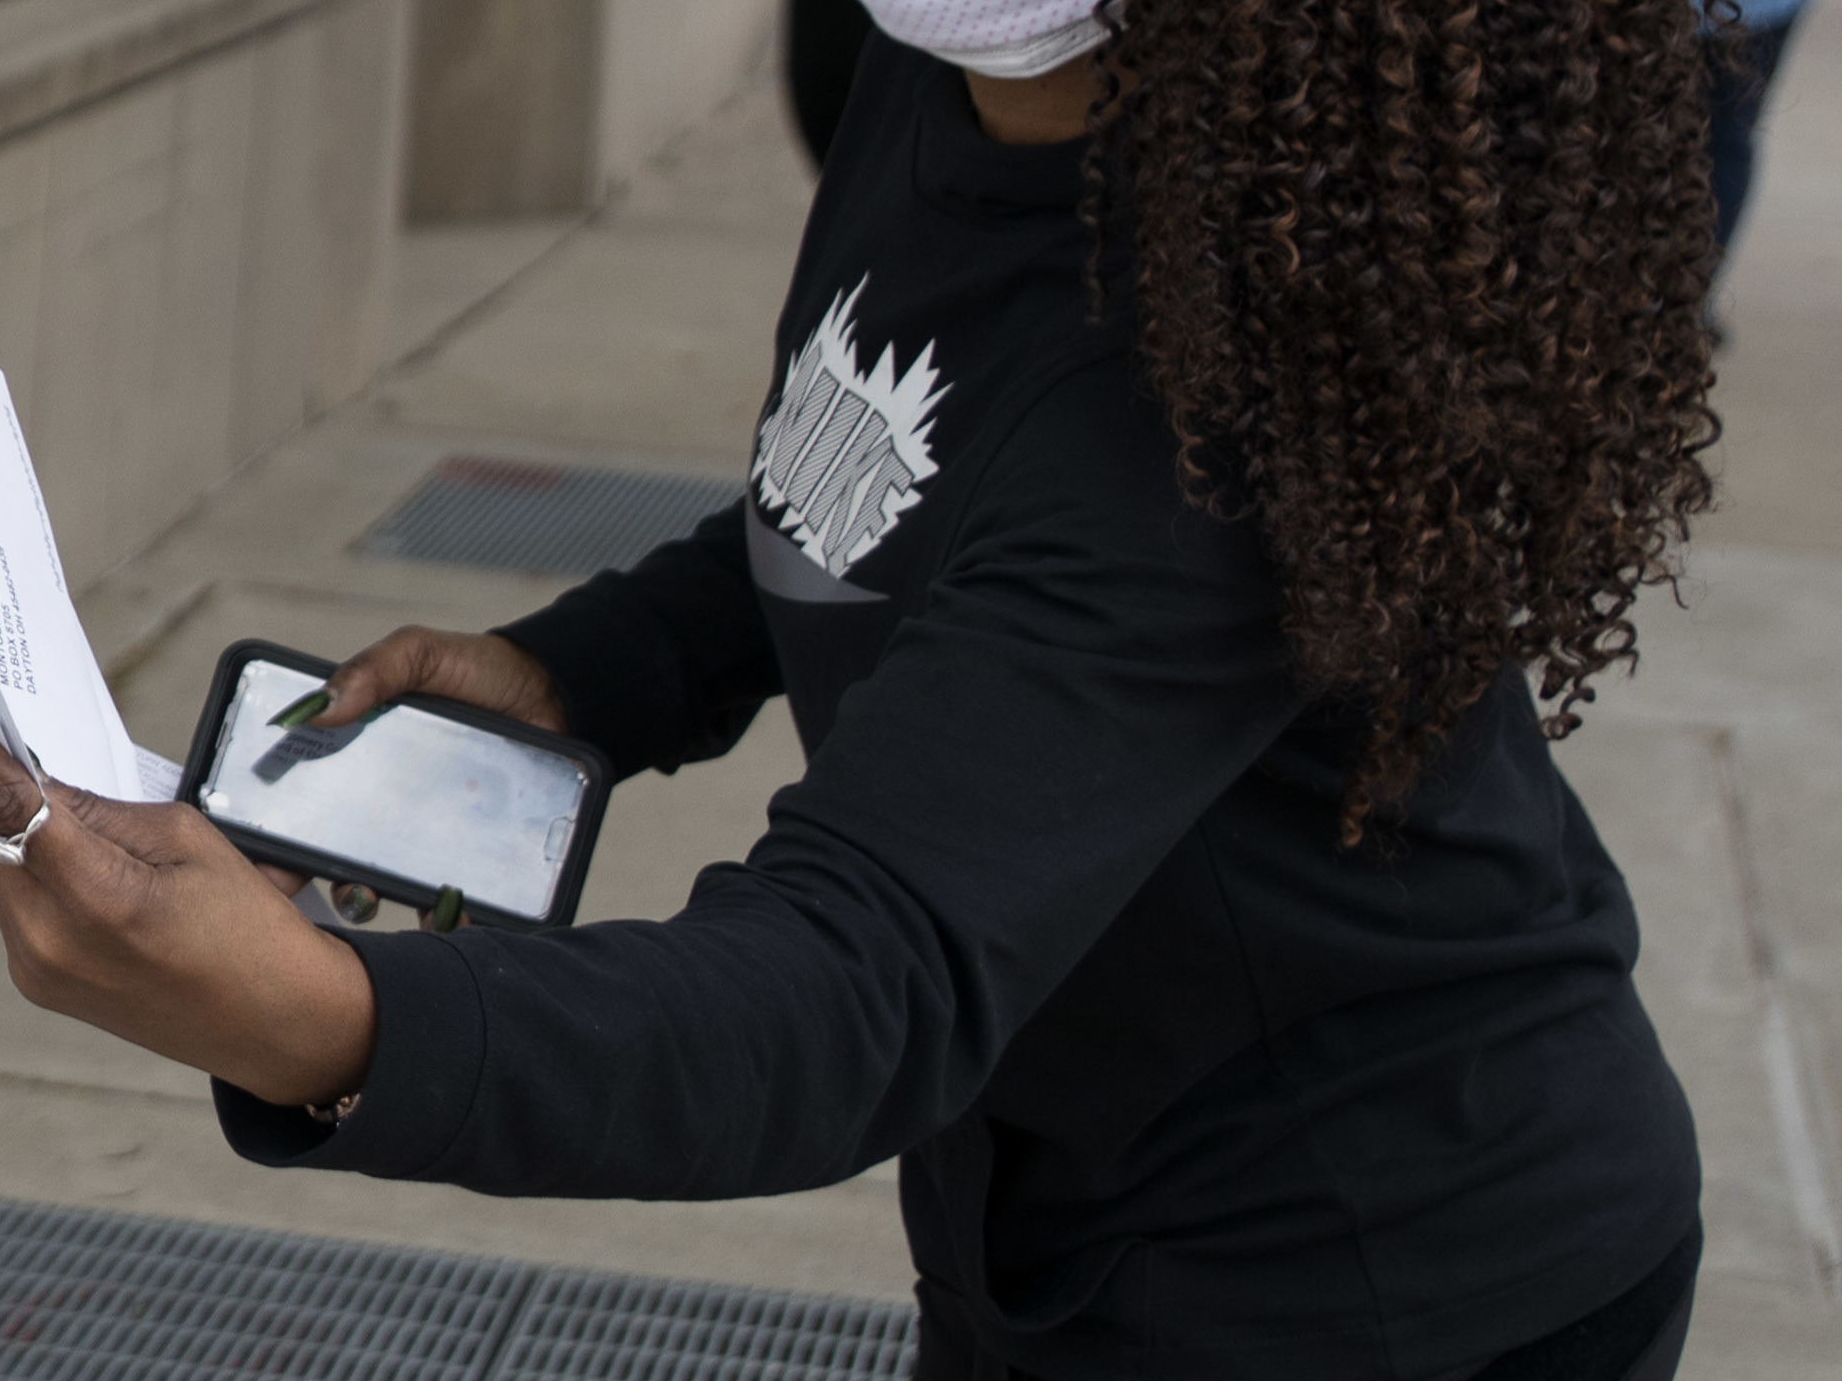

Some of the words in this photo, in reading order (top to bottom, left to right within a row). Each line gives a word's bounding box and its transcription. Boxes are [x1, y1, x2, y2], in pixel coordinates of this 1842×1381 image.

[1, 603, 14, 634] 8705
[14, 614, 25, 634] OH
[6, 636, 19, 666] BOX
[19, 637, 36, 694] DAYTON
[12, 670, 23, 690] PO
